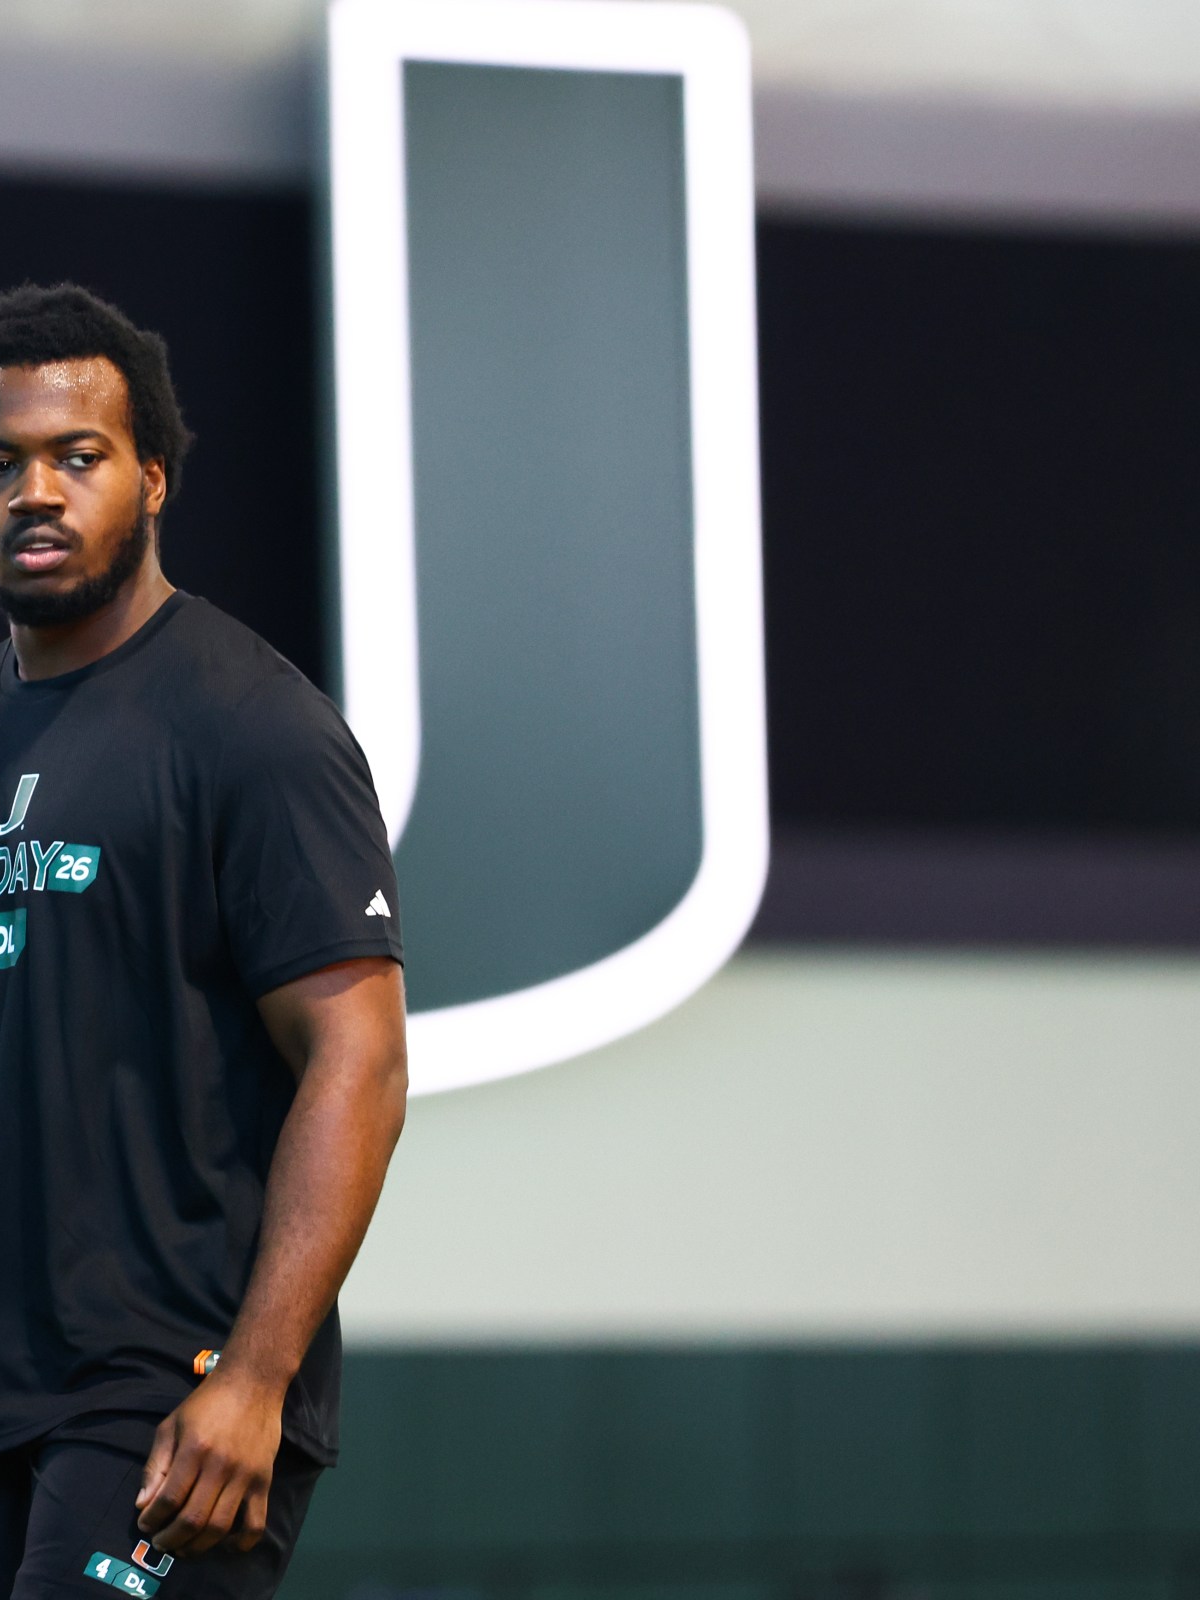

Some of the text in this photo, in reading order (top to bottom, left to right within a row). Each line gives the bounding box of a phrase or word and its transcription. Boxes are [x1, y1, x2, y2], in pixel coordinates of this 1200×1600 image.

[55, 853, 92, 881] 26
[95, 1558, 146, 1595] 4 DL
[131, 1539, 174, 1577] U
